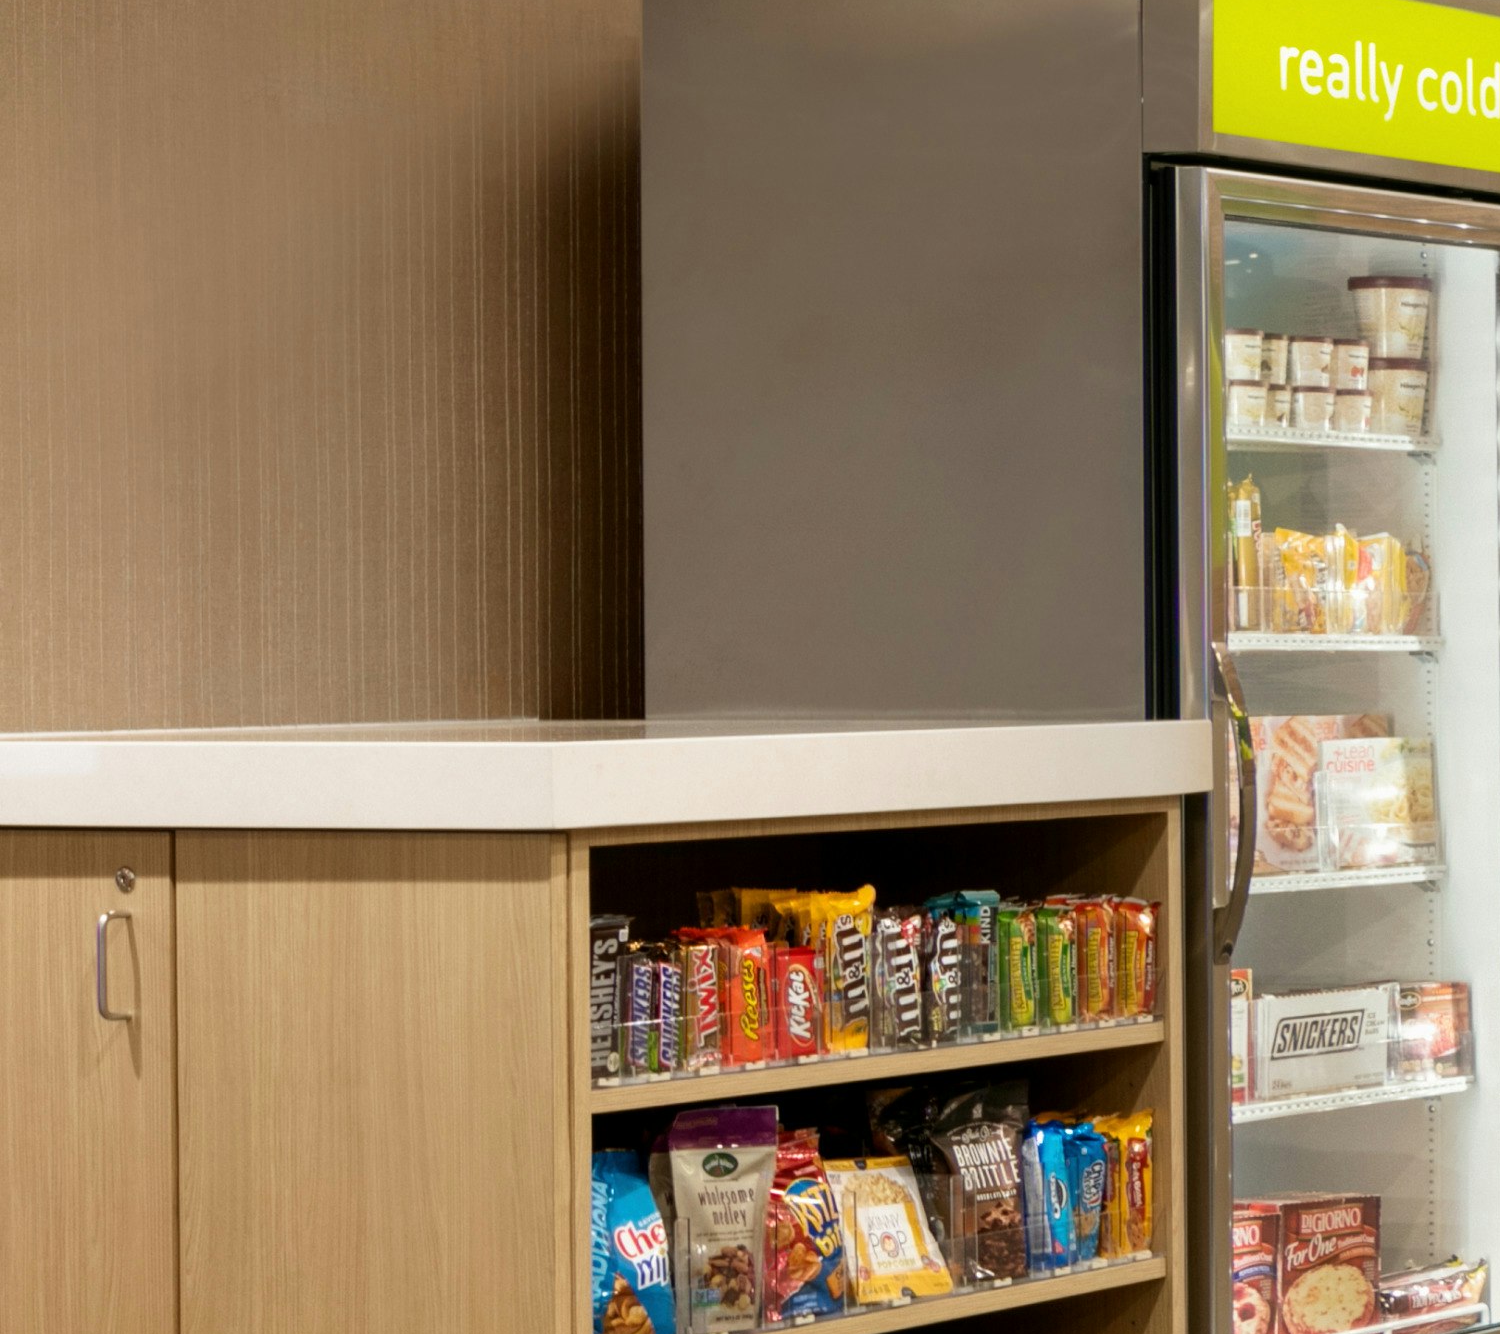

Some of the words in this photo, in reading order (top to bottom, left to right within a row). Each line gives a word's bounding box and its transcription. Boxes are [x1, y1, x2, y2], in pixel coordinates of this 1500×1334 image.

[1279, 40, 1404, 121] really
[1416, 57, 1500, 119] cold
[979, 905, 991, 945] KIND
[1276, 1015, 1360, 1054] SNICKERS
[952, 1138, 1016, 1167] BROWNIE
[960, 1160, 1021, 1191] BRITTLE
[697, 1187, 756, 1208] wholesome
[712, 1207, 748, 1228] medley
[1301, 1207, 1362, 1233] DIGIORNO
[614, 1223, 668, 1260] Che
[1284, 1240, 1309, 1272] For
[1308, 1233, 1337, 1263] One
